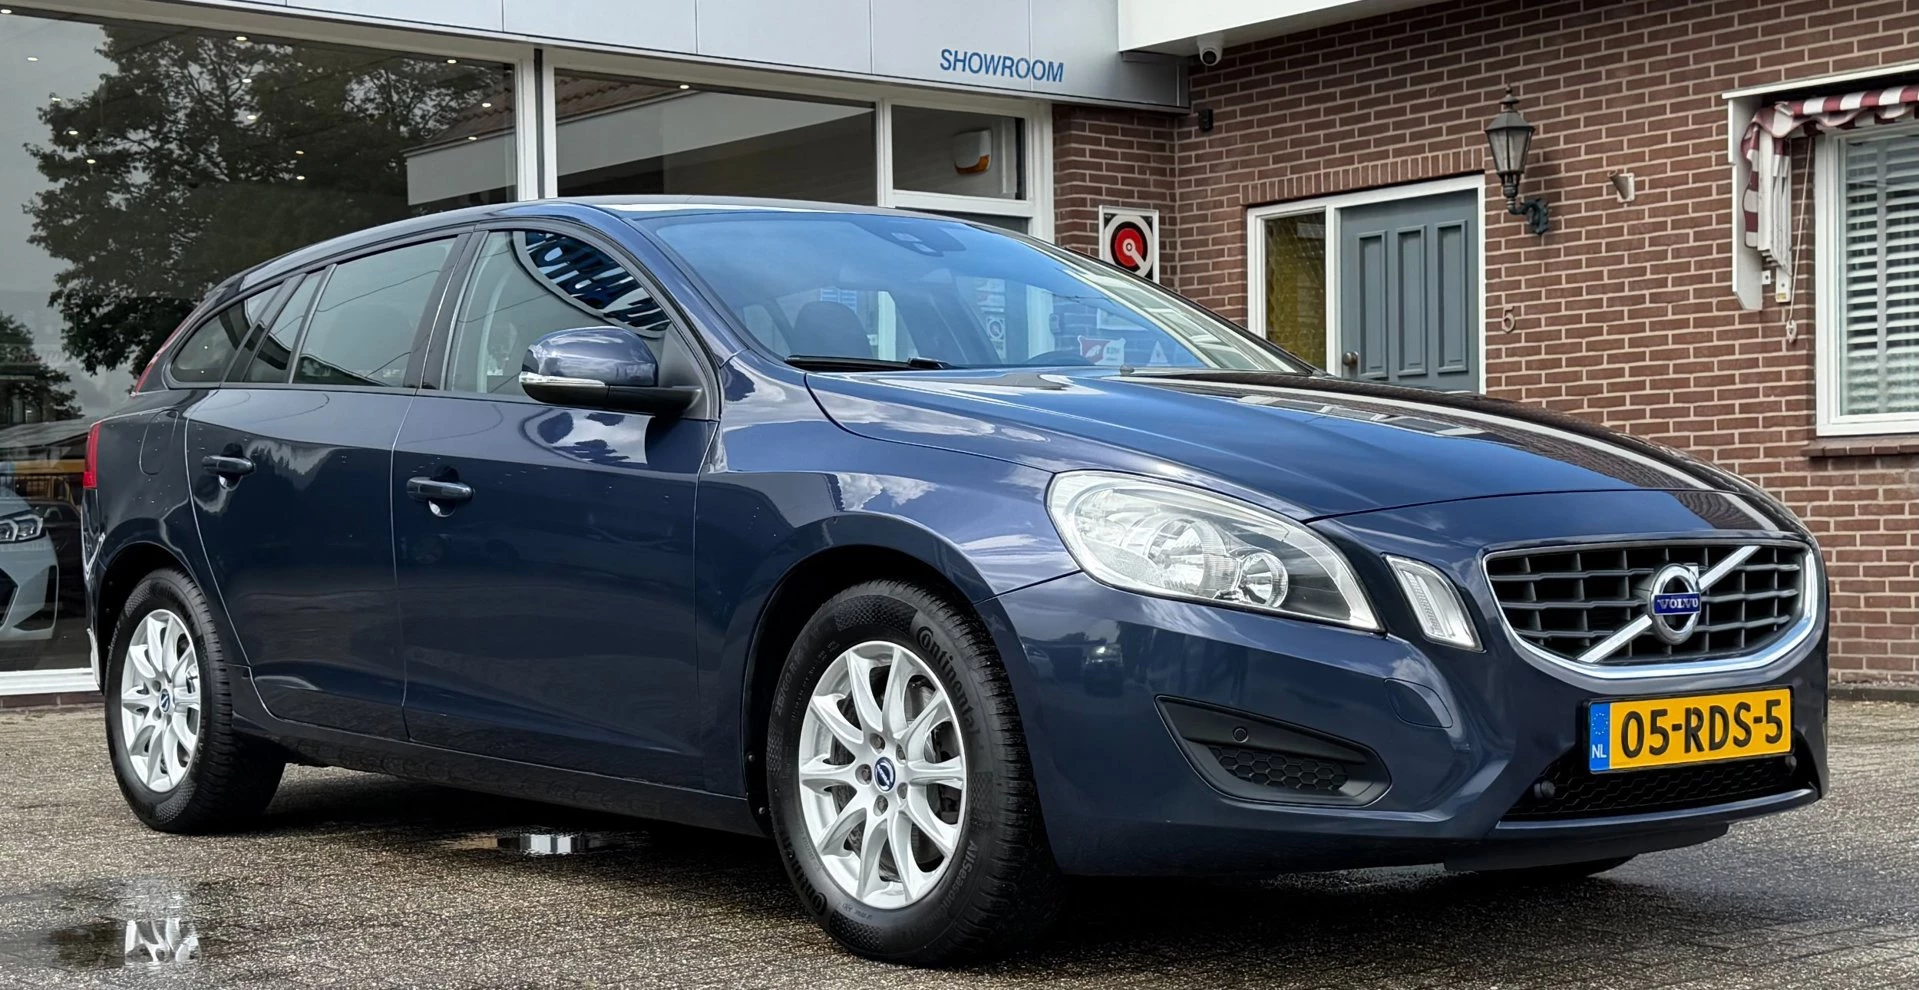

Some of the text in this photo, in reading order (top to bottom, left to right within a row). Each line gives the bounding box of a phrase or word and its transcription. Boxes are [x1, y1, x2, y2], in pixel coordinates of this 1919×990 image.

[940, 48, 1064, 83] SHOWROOM
[1502, 305, 1515, 332] 5
[1657, 597, 1699, 610] VOLVO
[916, 626, 981, 733] Continental
[1621, 698, 1784, 759] 05-RDS-5
[1591, 743, 1607, 759] NL
